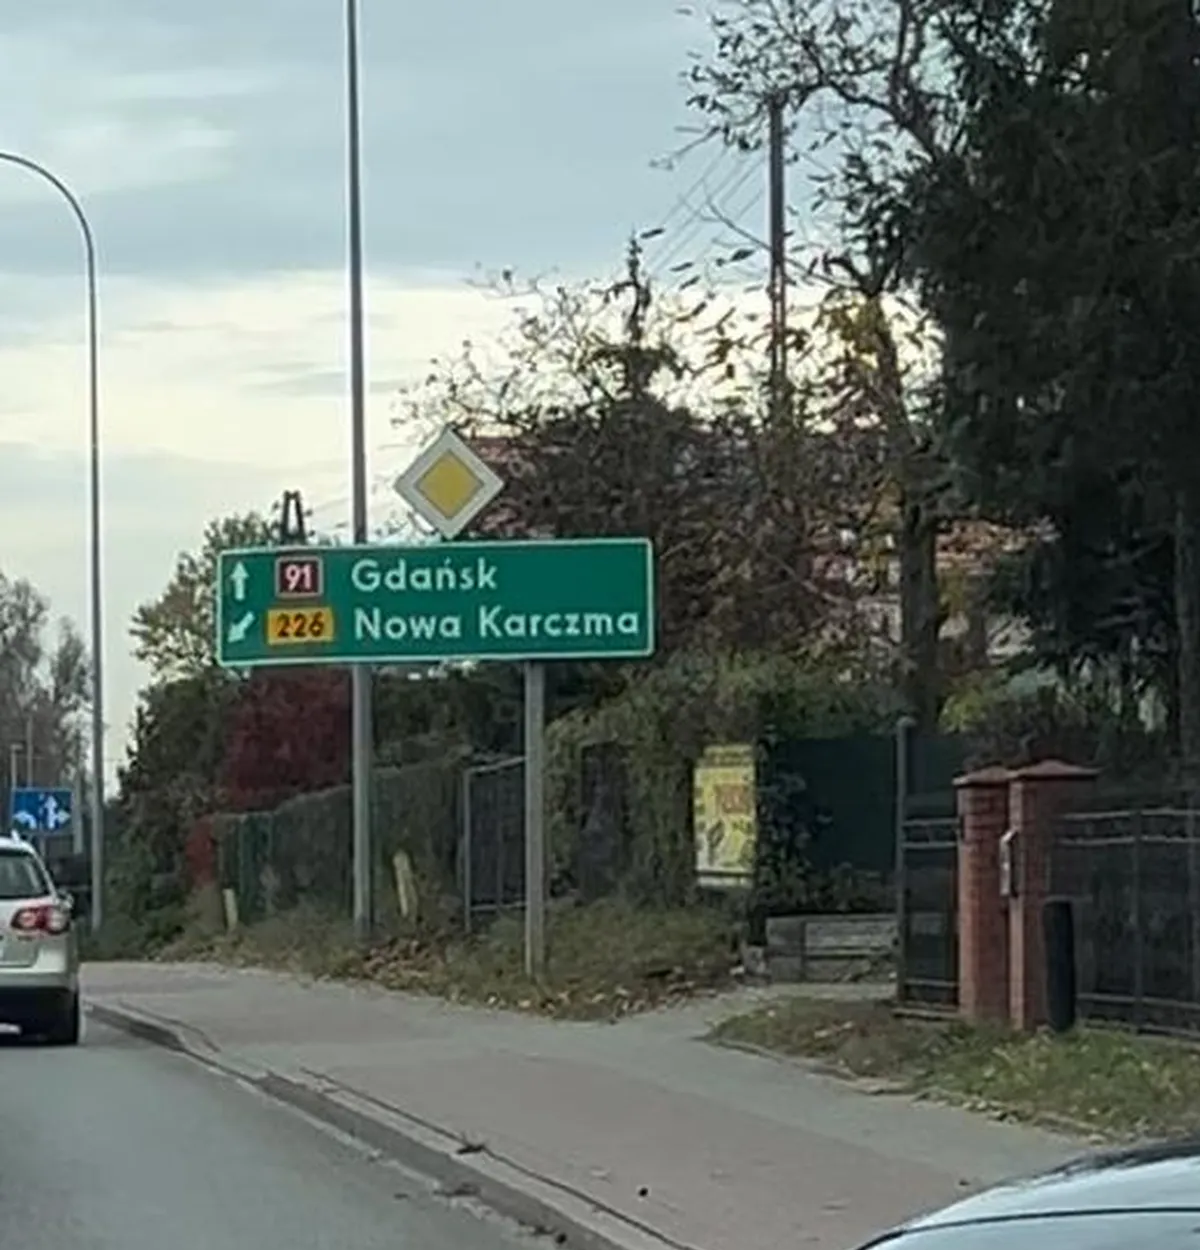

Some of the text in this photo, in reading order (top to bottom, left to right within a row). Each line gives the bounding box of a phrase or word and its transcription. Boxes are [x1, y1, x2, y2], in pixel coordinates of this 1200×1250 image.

[284, 558, 498, 593] 91 Gdańsk
[276, 605, 640, 641] 226 Nowa Karczma
